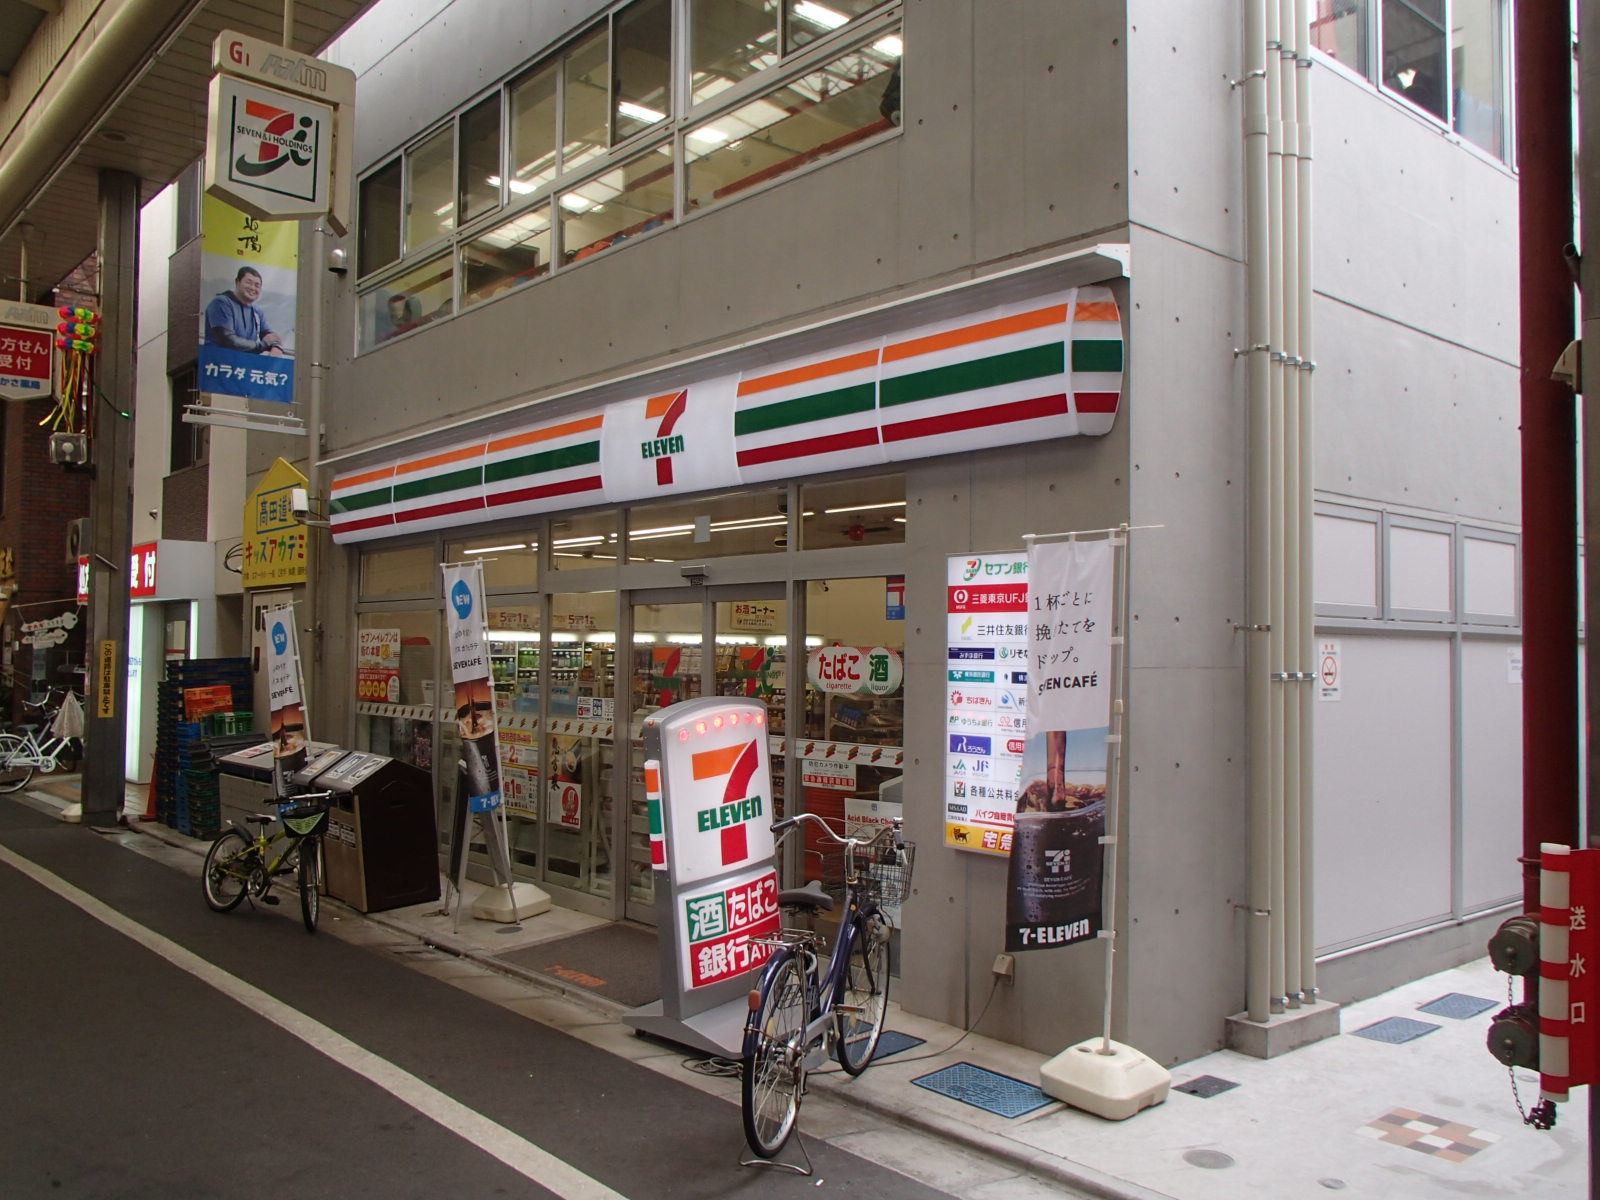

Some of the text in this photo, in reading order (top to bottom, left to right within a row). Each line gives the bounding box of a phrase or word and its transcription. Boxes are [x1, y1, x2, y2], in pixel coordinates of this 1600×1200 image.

[273, 136, 313, 154] HOLDINGS
[205, 362, 246, 380] カラダ
[641, 435, 684, 459] ELEVEN
[245, 534, 308, 566] キッズアカデミ
[736, 604, 775, 615] お酒コーナー
[819, 653, 889, 682] たばこ 酒
[1063, 670, 1098, 689] CAFÉ
[826, 682, 889, 692] cigarette liquor
[698, 796, 762, 833] ELEVEN
[847, 814, 861, 823] Acid
[862, 816, 879, 824] Black
[690, 878, 778, 940] 酒 たばこ
[1018, 918, 1090, 945] 7-ELEVEN
[1569, 906, 1586, 1024] 送水口
